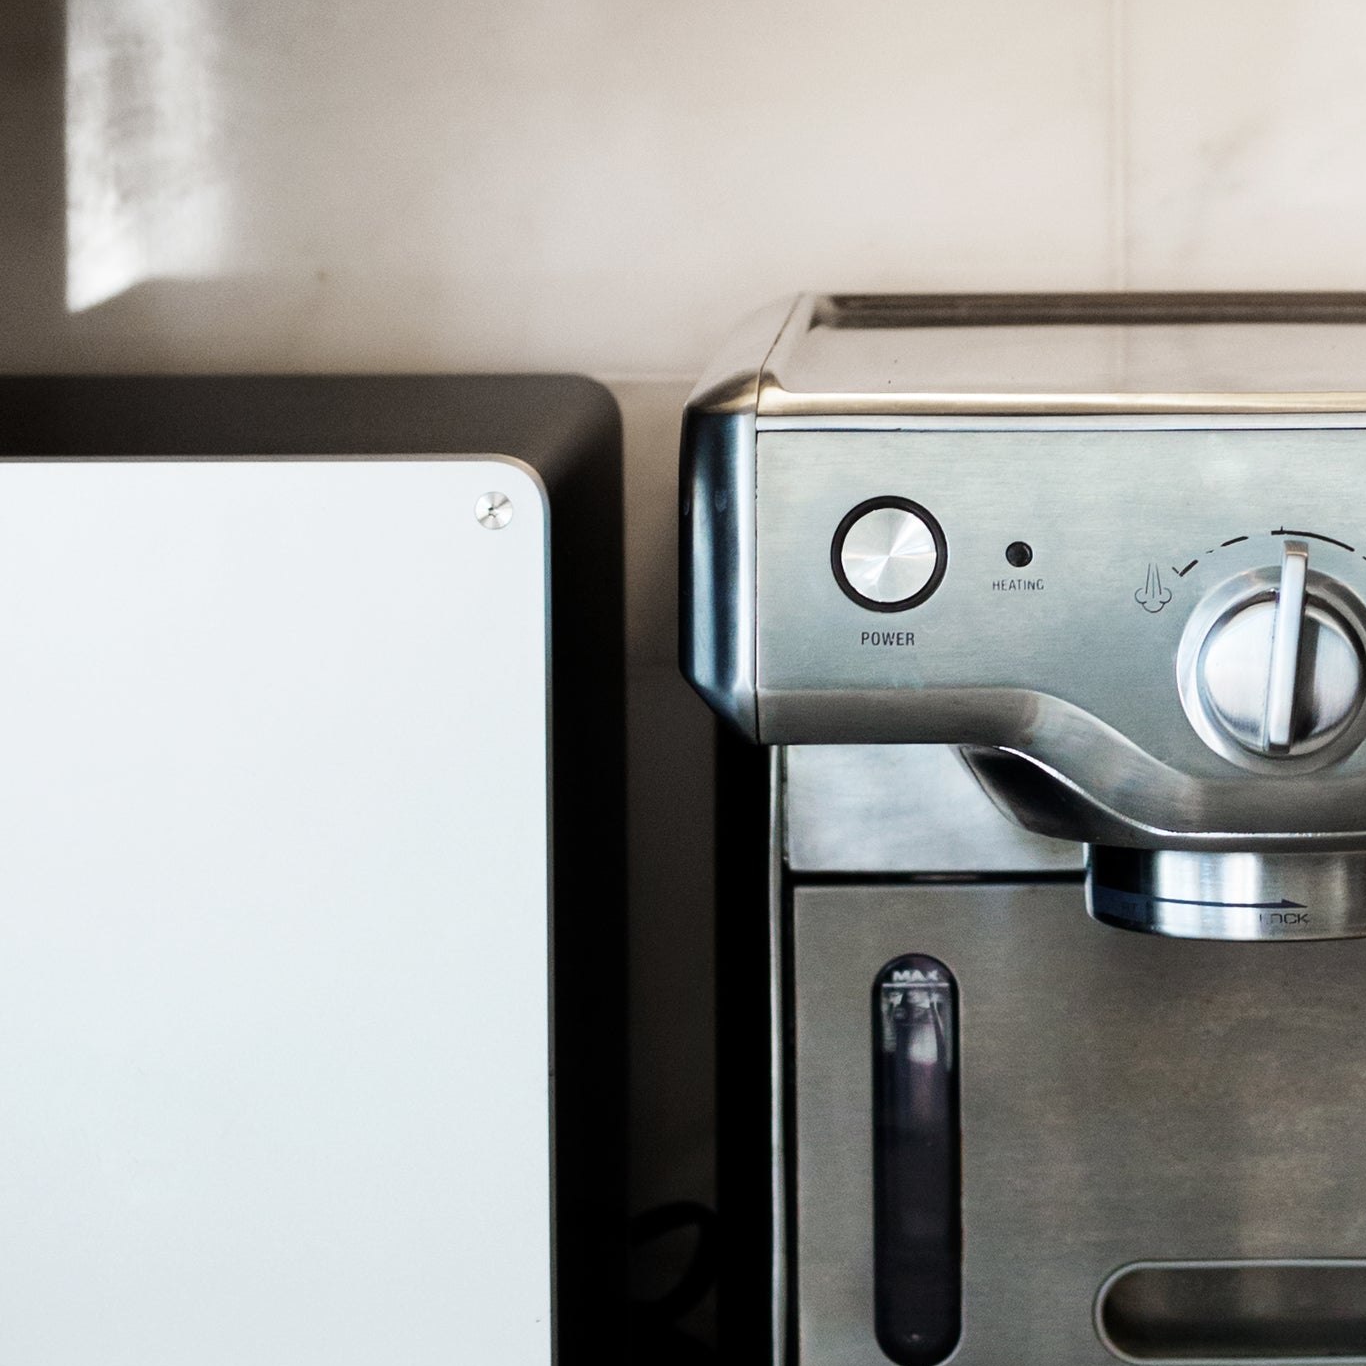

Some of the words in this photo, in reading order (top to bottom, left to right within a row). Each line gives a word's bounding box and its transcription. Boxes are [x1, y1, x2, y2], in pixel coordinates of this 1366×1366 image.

[992, 578, 1045, 591] HEATING
[861, 631, 915, 646] POWER
[893, 969, 939, 981] MAX
